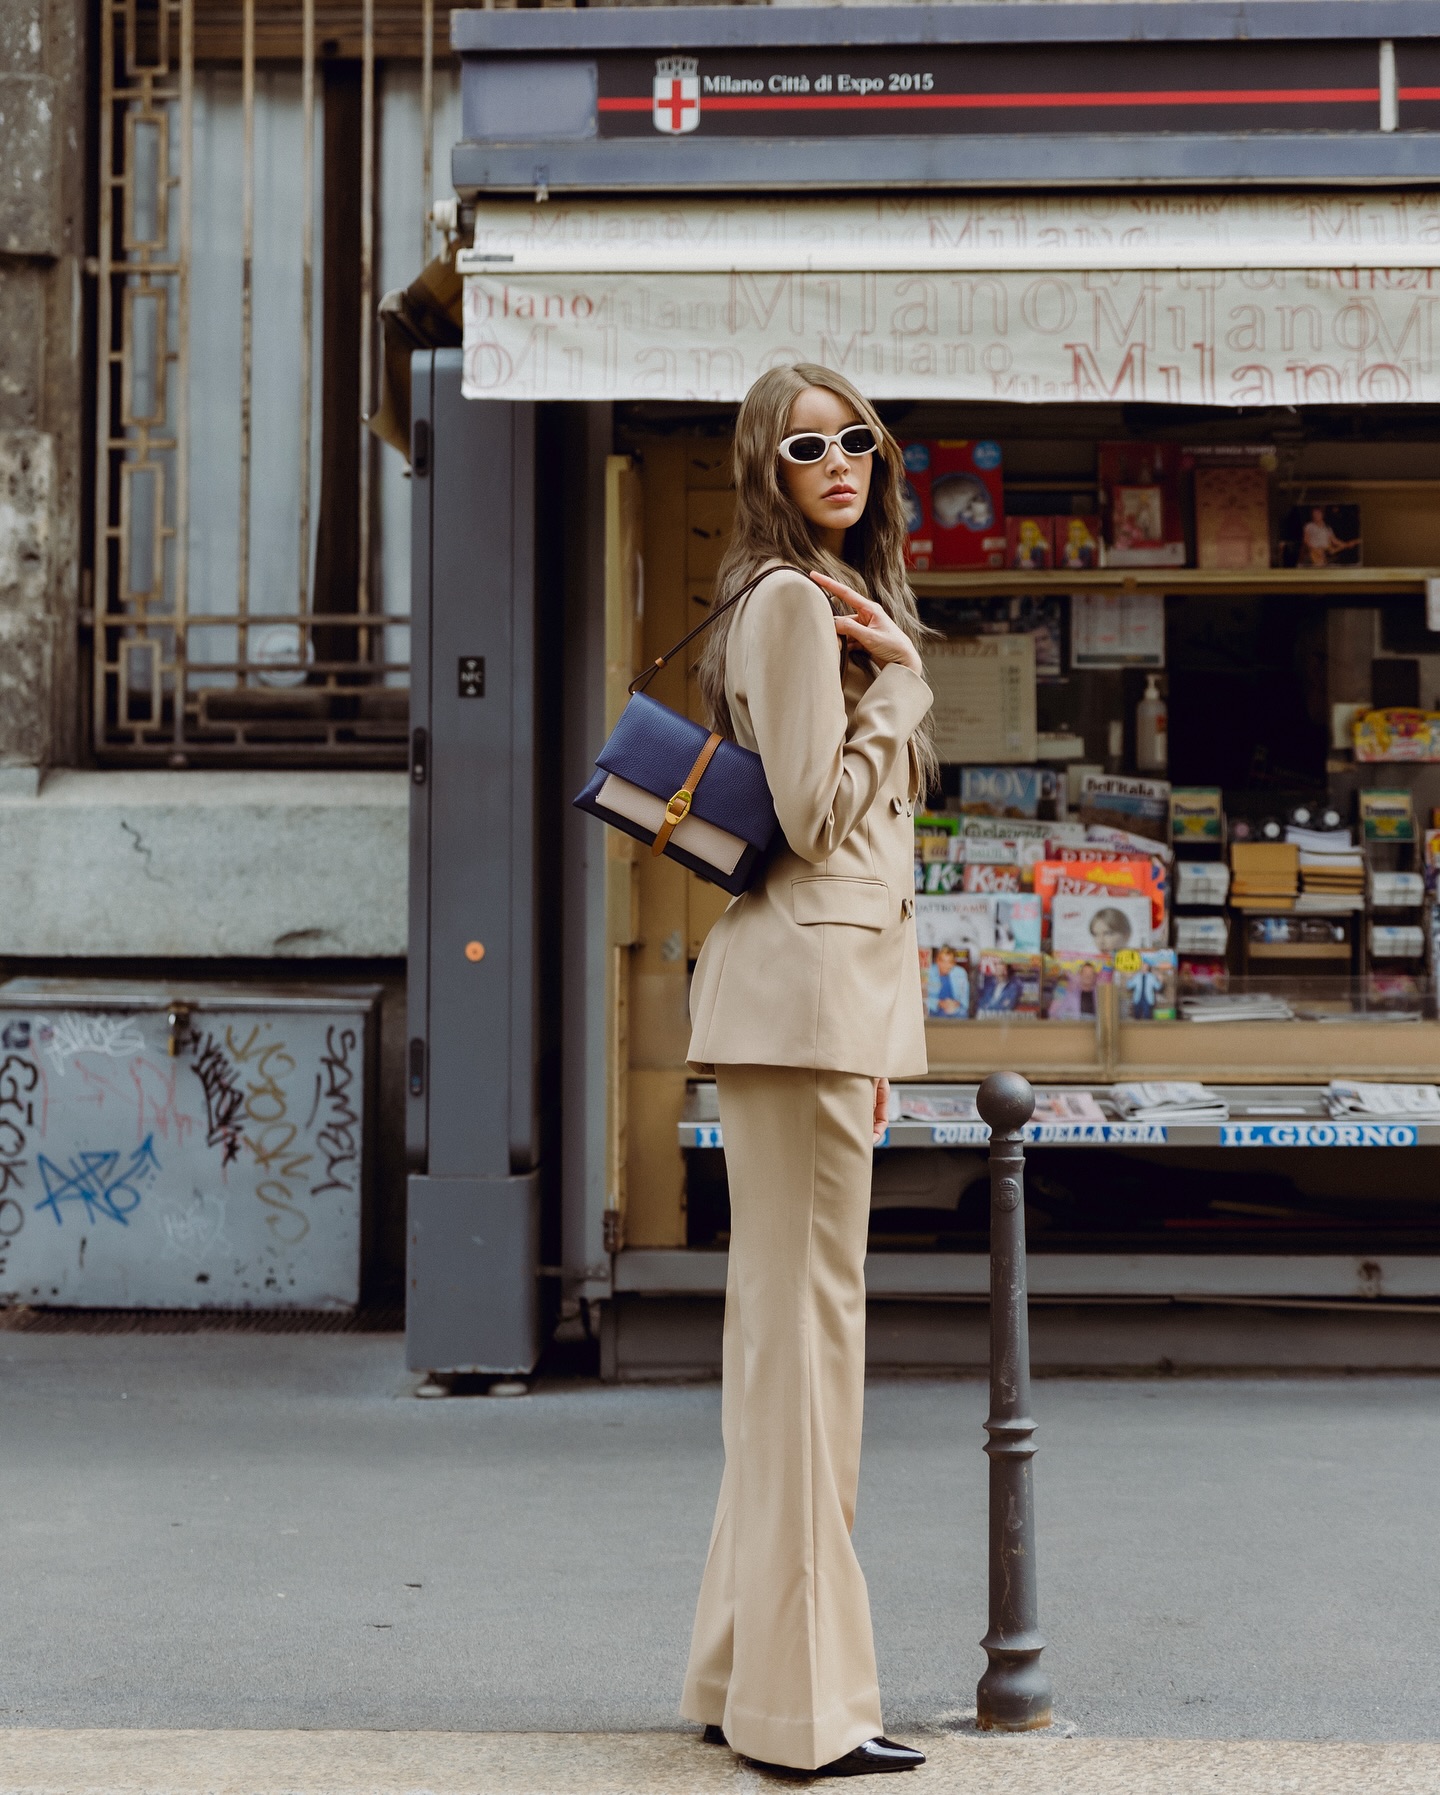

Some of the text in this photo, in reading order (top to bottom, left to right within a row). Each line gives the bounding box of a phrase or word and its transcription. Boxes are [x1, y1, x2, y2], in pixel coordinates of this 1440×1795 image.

[703, 73, 935, 95] Milano Città di Expo 2015
[730, 272, 1076, 336] Milano
[1083, 286, 1378, 352] Milano
[818, 330, 1013, 376] Milano
[1063, 342, 1415, 404] Milano
[1042, 1126, 1106, 1144] DELLA
[1107, 1126, 1167, 1144] SERA
[1223, 1126, 1415, 1147] IL GIORNO
